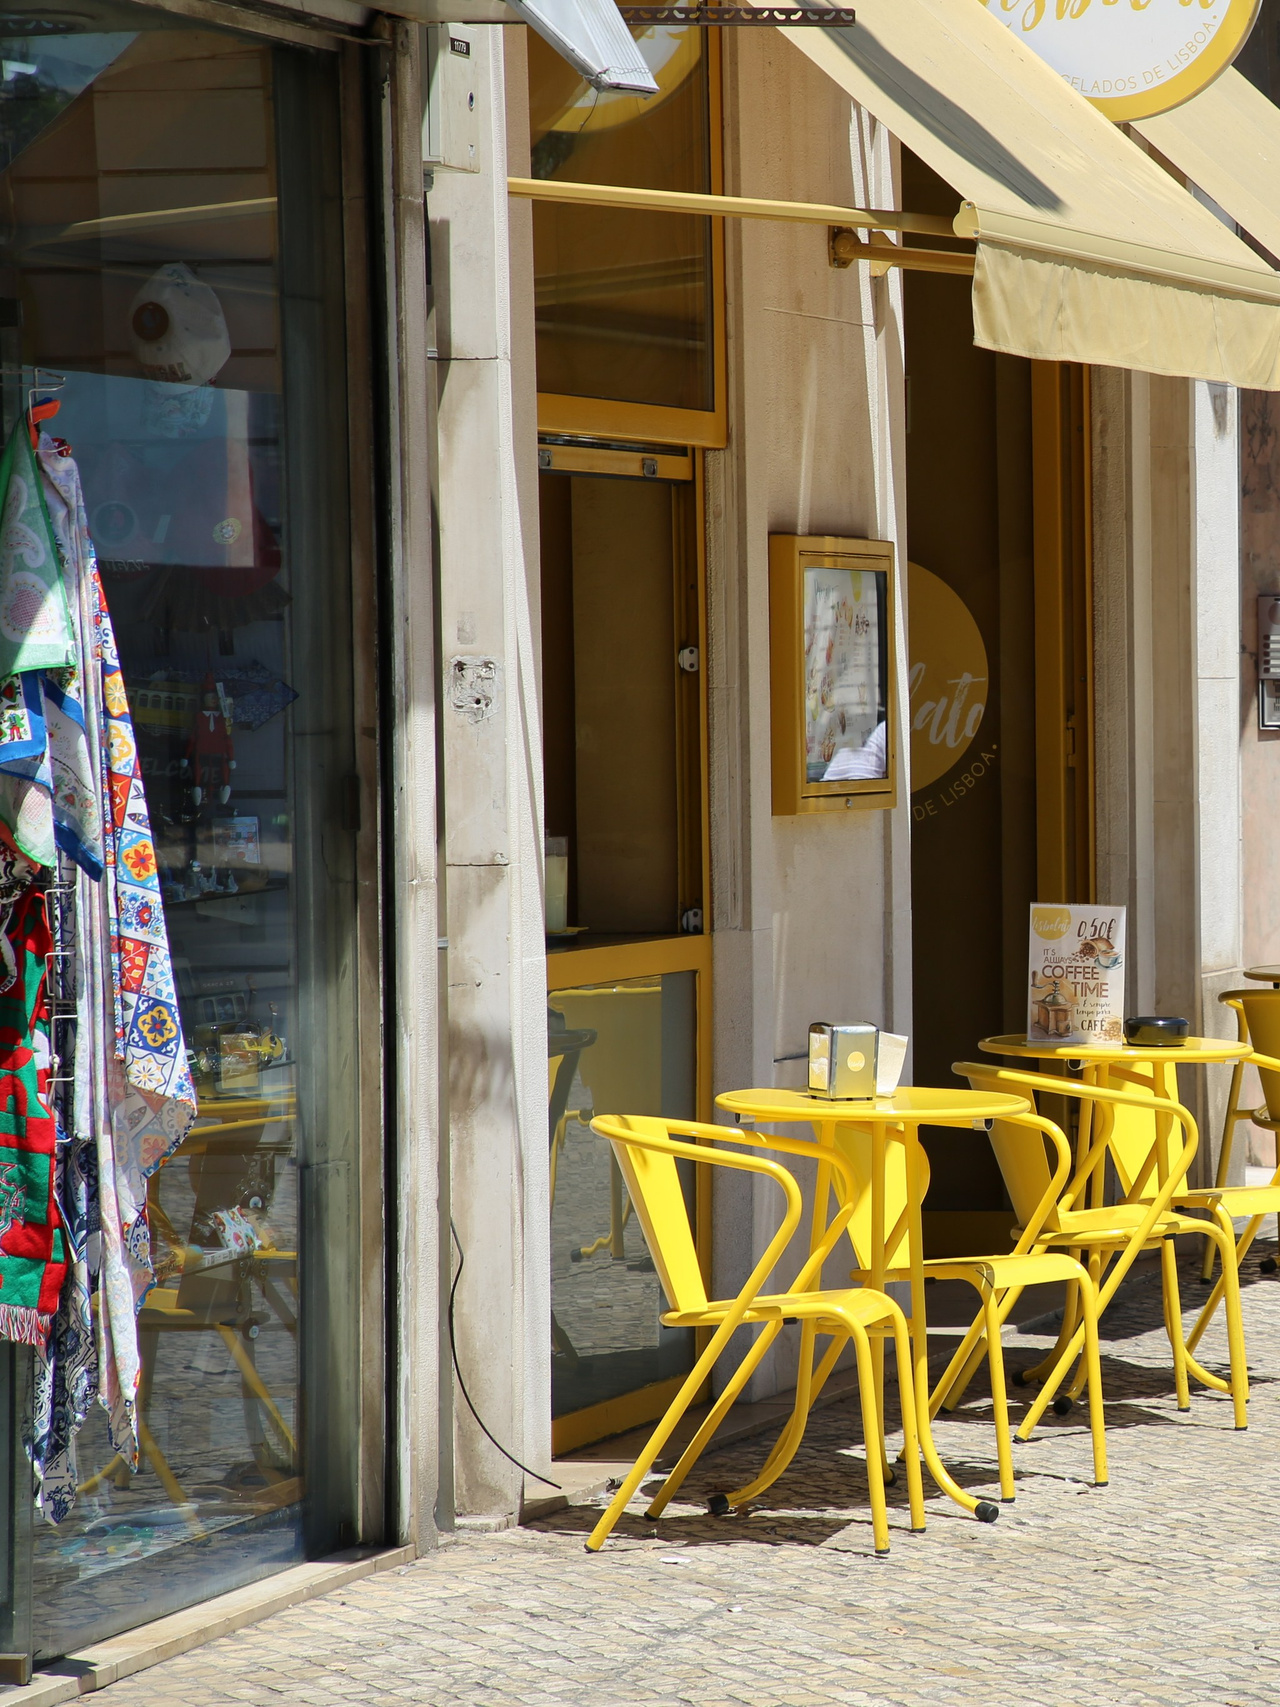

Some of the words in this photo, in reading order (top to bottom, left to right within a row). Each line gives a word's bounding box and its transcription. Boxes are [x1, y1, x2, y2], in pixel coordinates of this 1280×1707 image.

[1142, 65, 1165, 85] DE
[913, 803, 938, 821] DE
[1077, 918, 1116, 940] 0,50€
[1043, 956, 1073, 964] ALWAYS
[1042, 965, 1100, 980] COFFEE
[1071, 981, 1109, 998] TIME
[1081, 1018, 1107, 1031] CAFÉ
